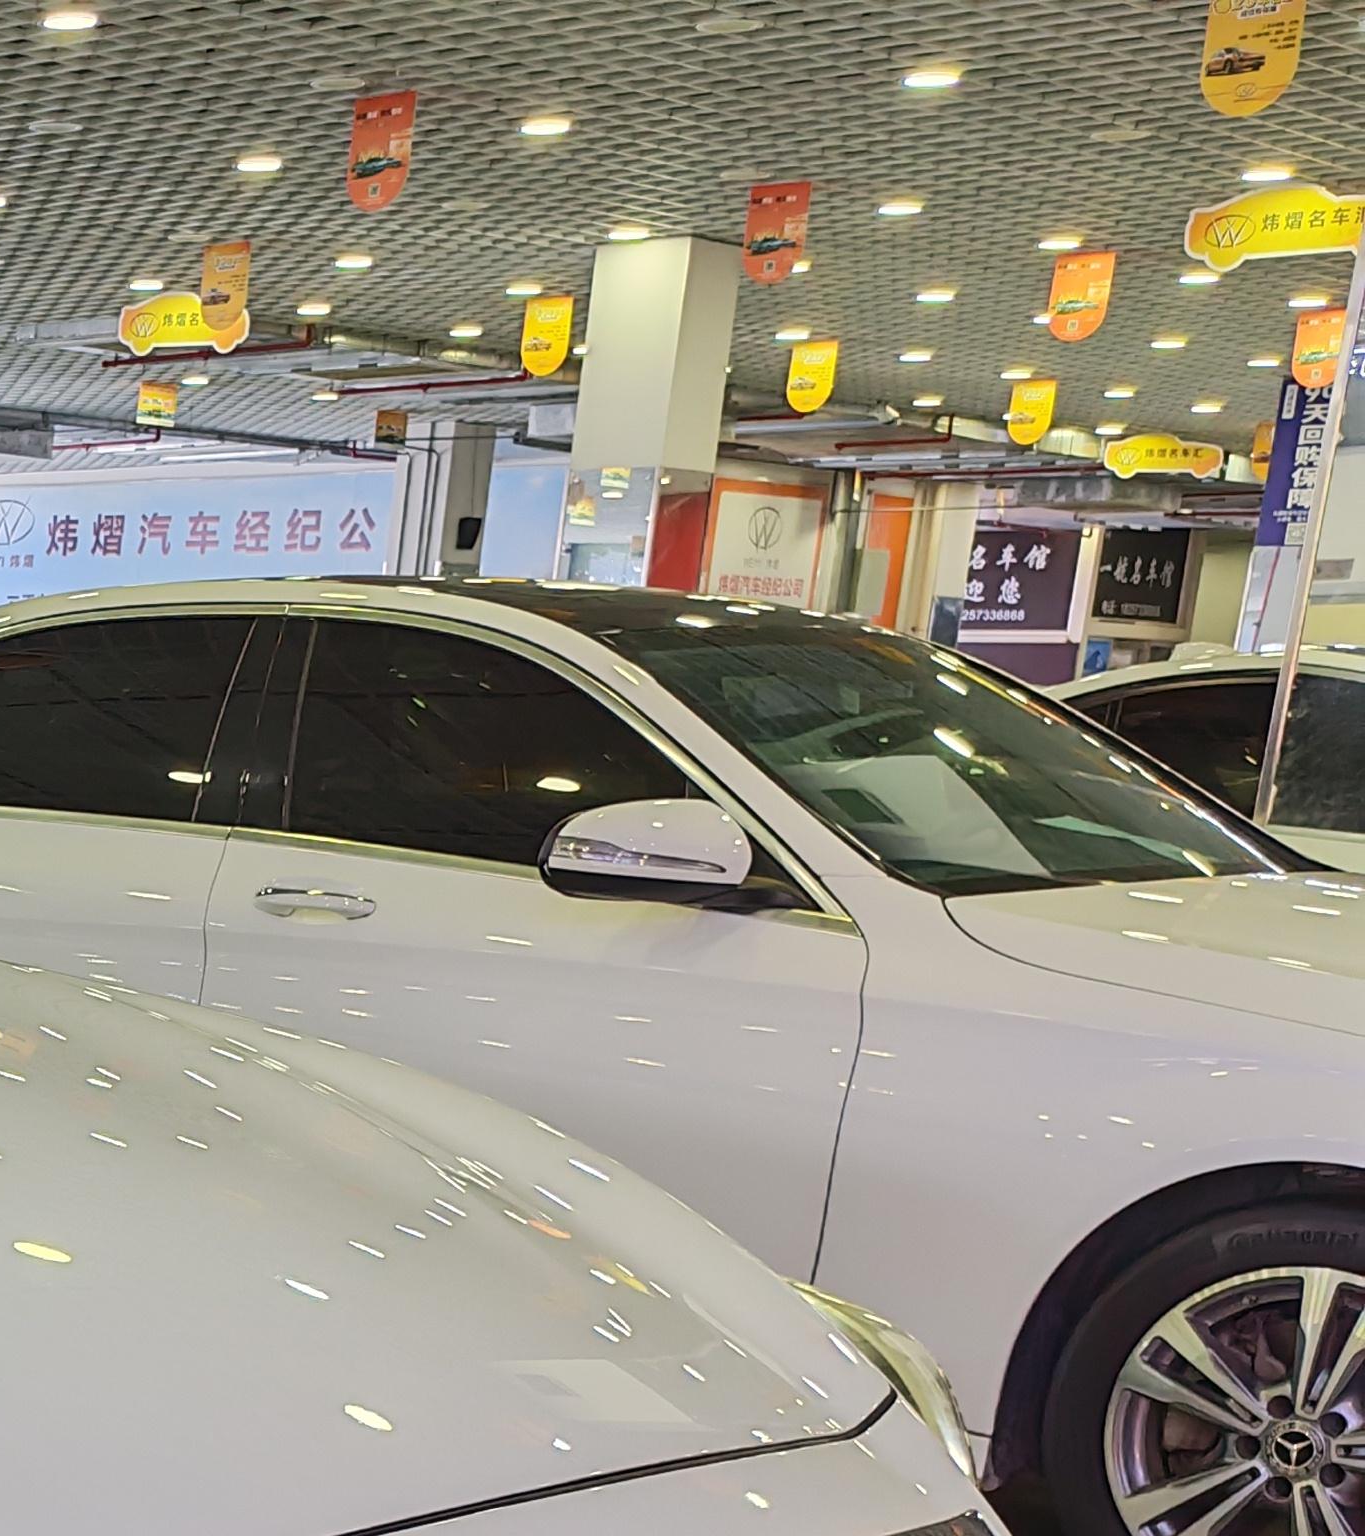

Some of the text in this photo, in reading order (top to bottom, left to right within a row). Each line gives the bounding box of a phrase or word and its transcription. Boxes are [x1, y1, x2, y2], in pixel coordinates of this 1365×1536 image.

[46, 507, 377, 558] 炜熠汽车经纪公
